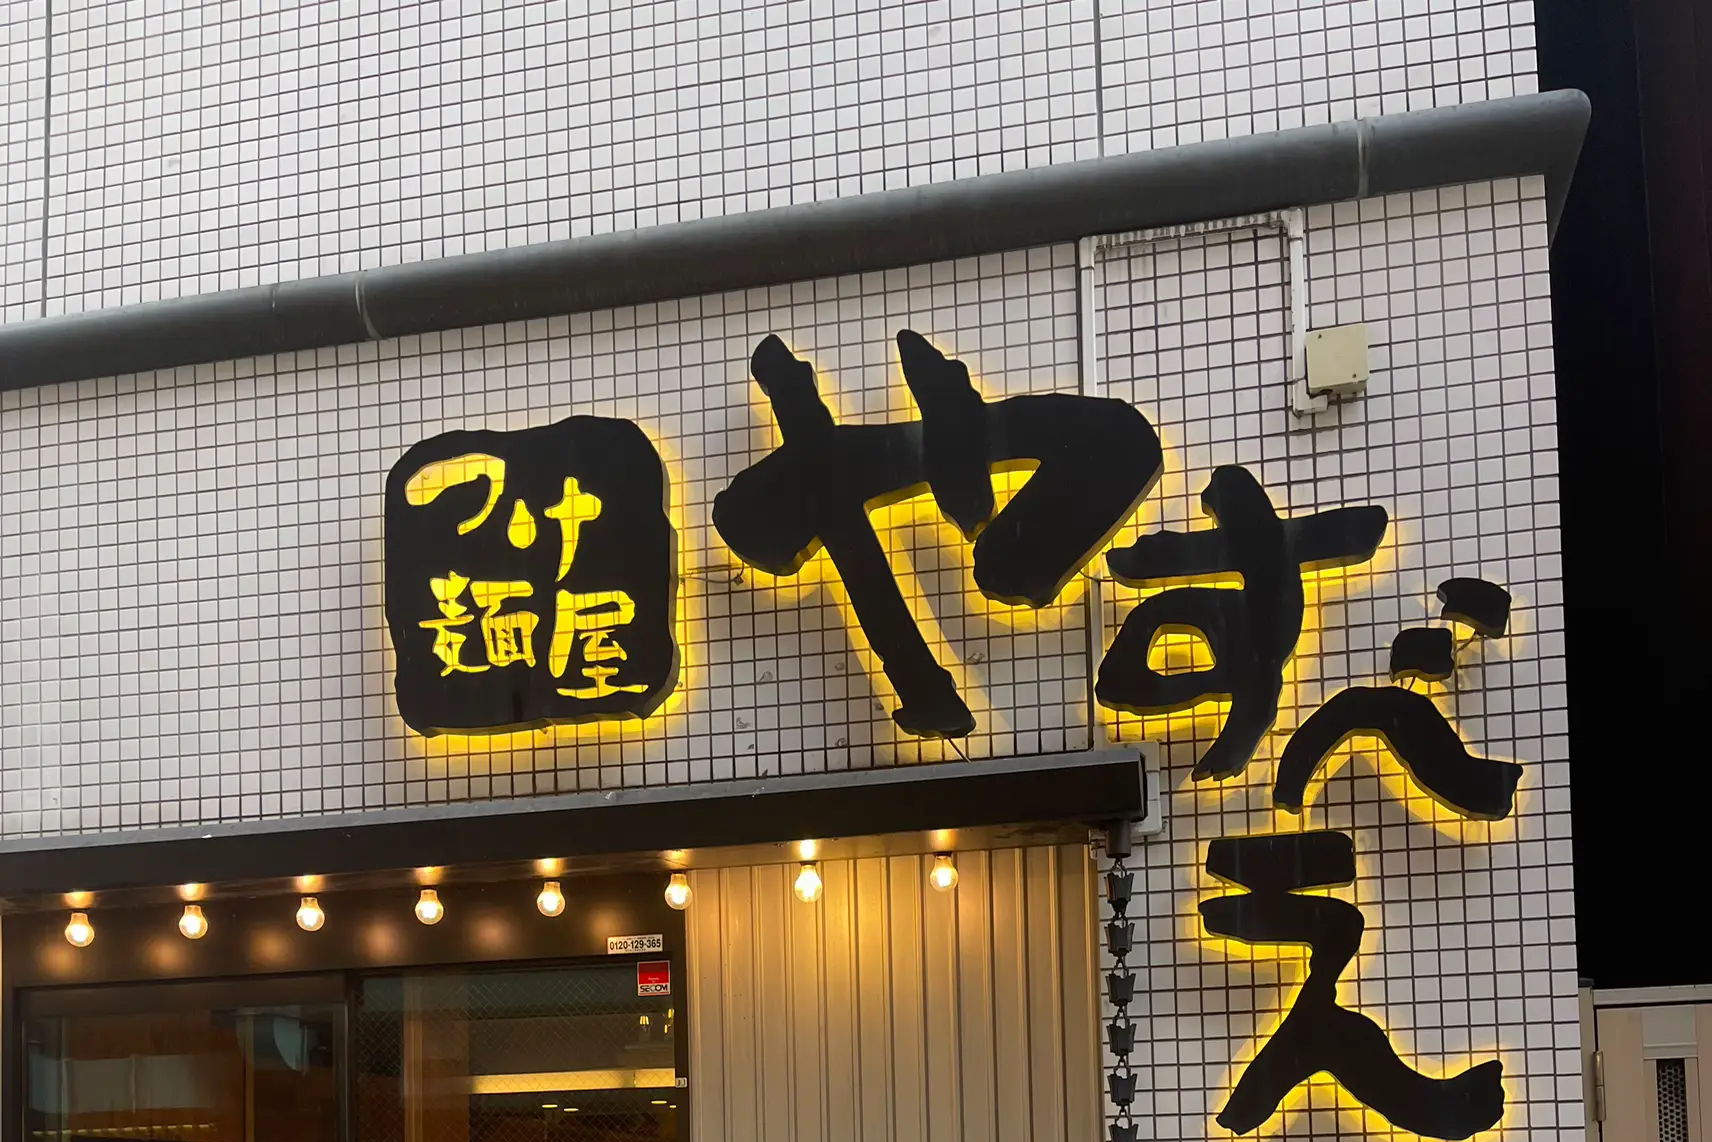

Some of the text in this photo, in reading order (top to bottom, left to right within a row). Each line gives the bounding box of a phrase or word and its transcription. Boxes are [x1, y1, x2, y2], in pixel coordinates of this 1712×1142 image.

[405, 453, 602, 582] つけ
[713, 329, 1523, 1141] やすべえ
[609, 938, 661, 950] 0120-129-365
[640, 984, 668, 993] SECOM
